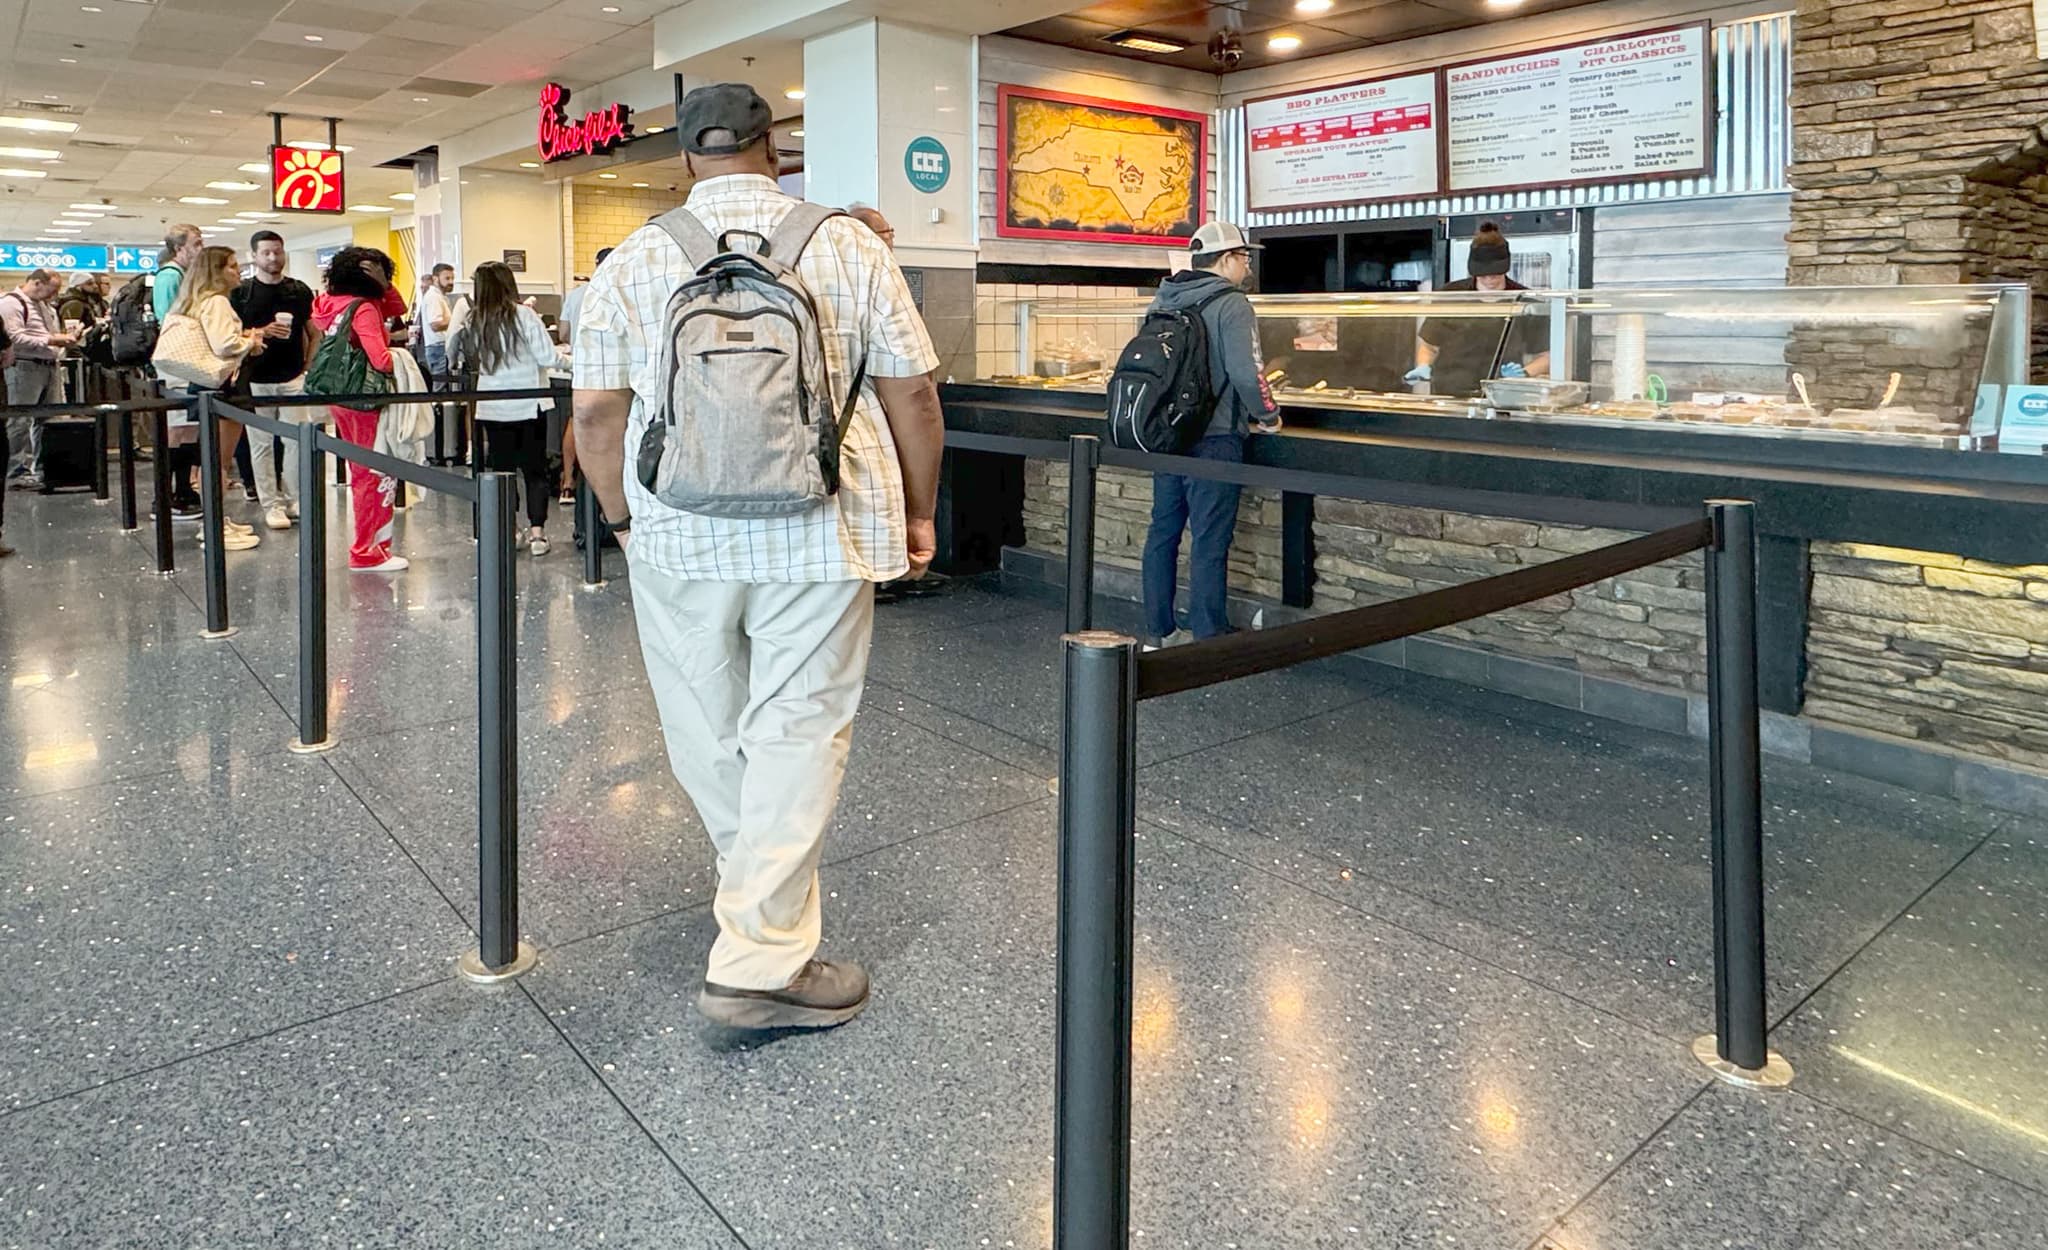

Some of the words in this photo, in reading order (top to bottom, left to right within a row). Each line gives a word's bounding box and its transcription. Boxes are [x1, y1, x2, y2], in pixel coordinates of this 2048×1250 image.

[1583, 34, 1681, 57] CHARLOTTE
[1579, 57, 1606, 68] PIT
[1610, 45, 1687, 64] CLASSICS
[1451, 57, 1560, 83] SANDWICHES
[1569, 74, 1602, 83] Country
[1604, 68, 1637, 78] Garden
[1450, 91, 1481, 101] Chopped
[1483, 88, 1499, 96] BBQ
[1500, 84, 1532, 94] Chicken
[1286, 99, 1311, 110] BBQ
[1315, 87, 1386, 105] PLATTERS
[1570, 106, 1591, 114] Dirty
[1593, 102, 1618, 111] South
[1451, 114, 1474, 123] Pulled
[1570, 113, 1587, 121] Mac
[1598, 108, 1629, 118] Cheese
[1481, 133, 1509, 142] Brisket
[1633, 131, 1680, 141] Cucumber
[1324, 143, 1347, 151] YOUR
[1570, 138, 1604, 147] Broccoli
[1642, 139, 1677, 148] Tomato
[1578, 145, 1610, 153] Tomato
[1497, 154, 1525, 162] Turkey
[1570, 153, 1594, 161] Salad
[1634, 151, 1662, 160] Baked
[1665, 150, 1694, 158] Potato
[1634, 160, 1659, 168] Salad
[1570, 165, 1607, 174] Coleslaw
[915, 173, 940, 181] LOCAL
